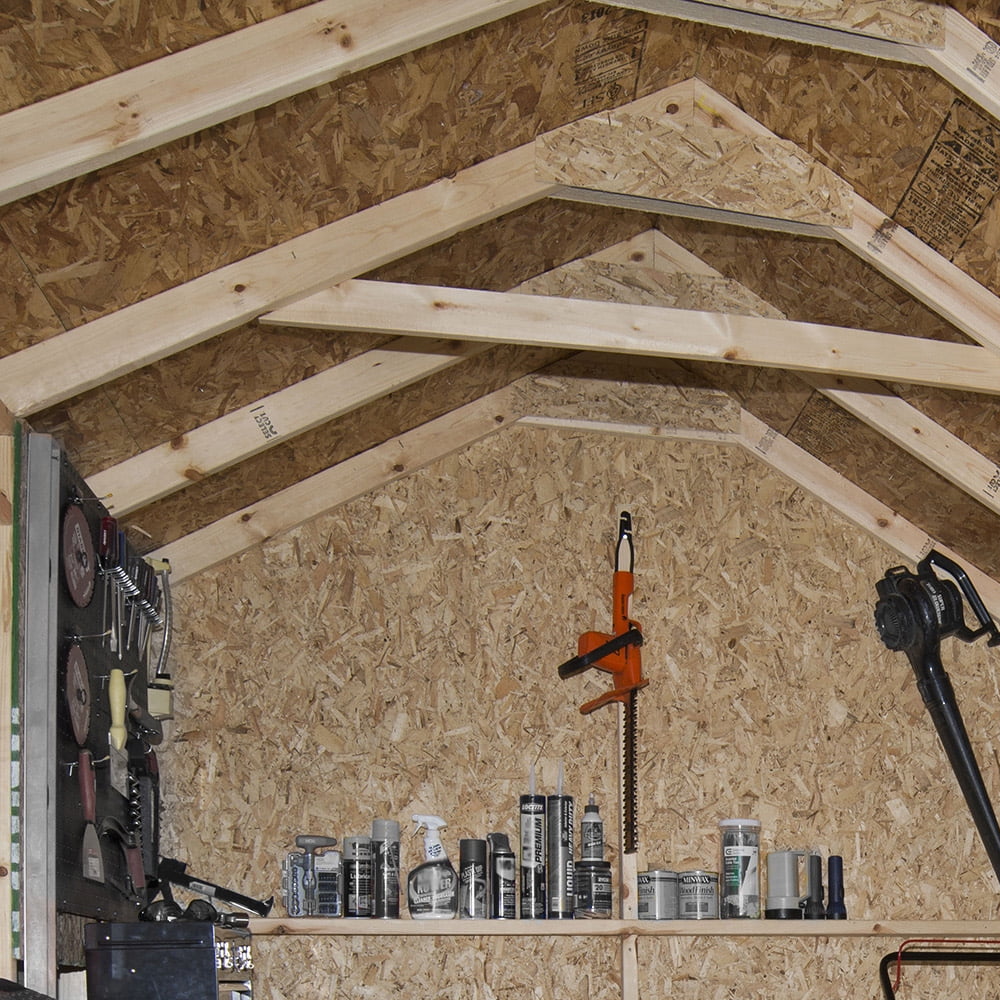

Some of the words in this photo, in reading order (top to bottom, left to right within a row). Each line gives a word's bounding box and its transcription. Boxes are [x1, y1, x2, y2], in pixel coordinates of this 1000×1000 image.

[259, 411, 271, 426] CUT
[253, 414, 272, 439] SELECT
[682, 876, 710, 884] MINWAX
